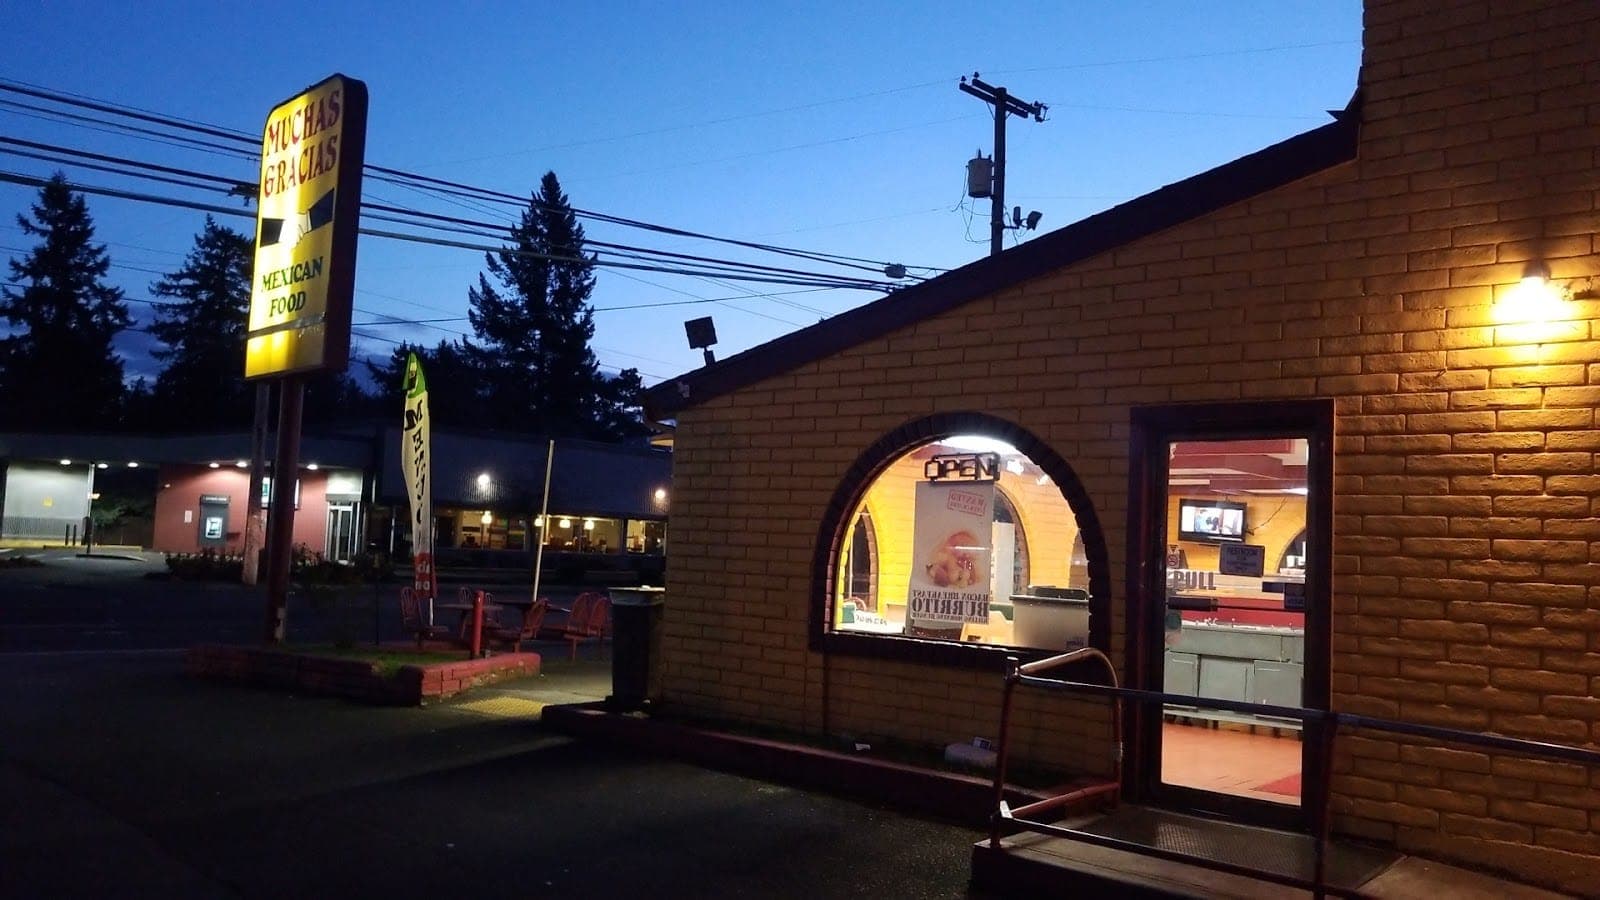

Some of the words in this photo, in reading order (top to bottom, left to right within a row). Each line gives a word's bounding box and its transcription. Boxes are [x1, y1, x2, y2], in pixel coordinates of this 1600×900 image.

[265, 89, 342, 157] MUCHAS
[263, 135, 338, 198] GRACIAS
[261, 256, 323, 292] MEXICAN
[269, 291, 306, 318] FOOD
[925, 455, 996, 481] OPEN
[1173, 571, 1216, 590] PULL
